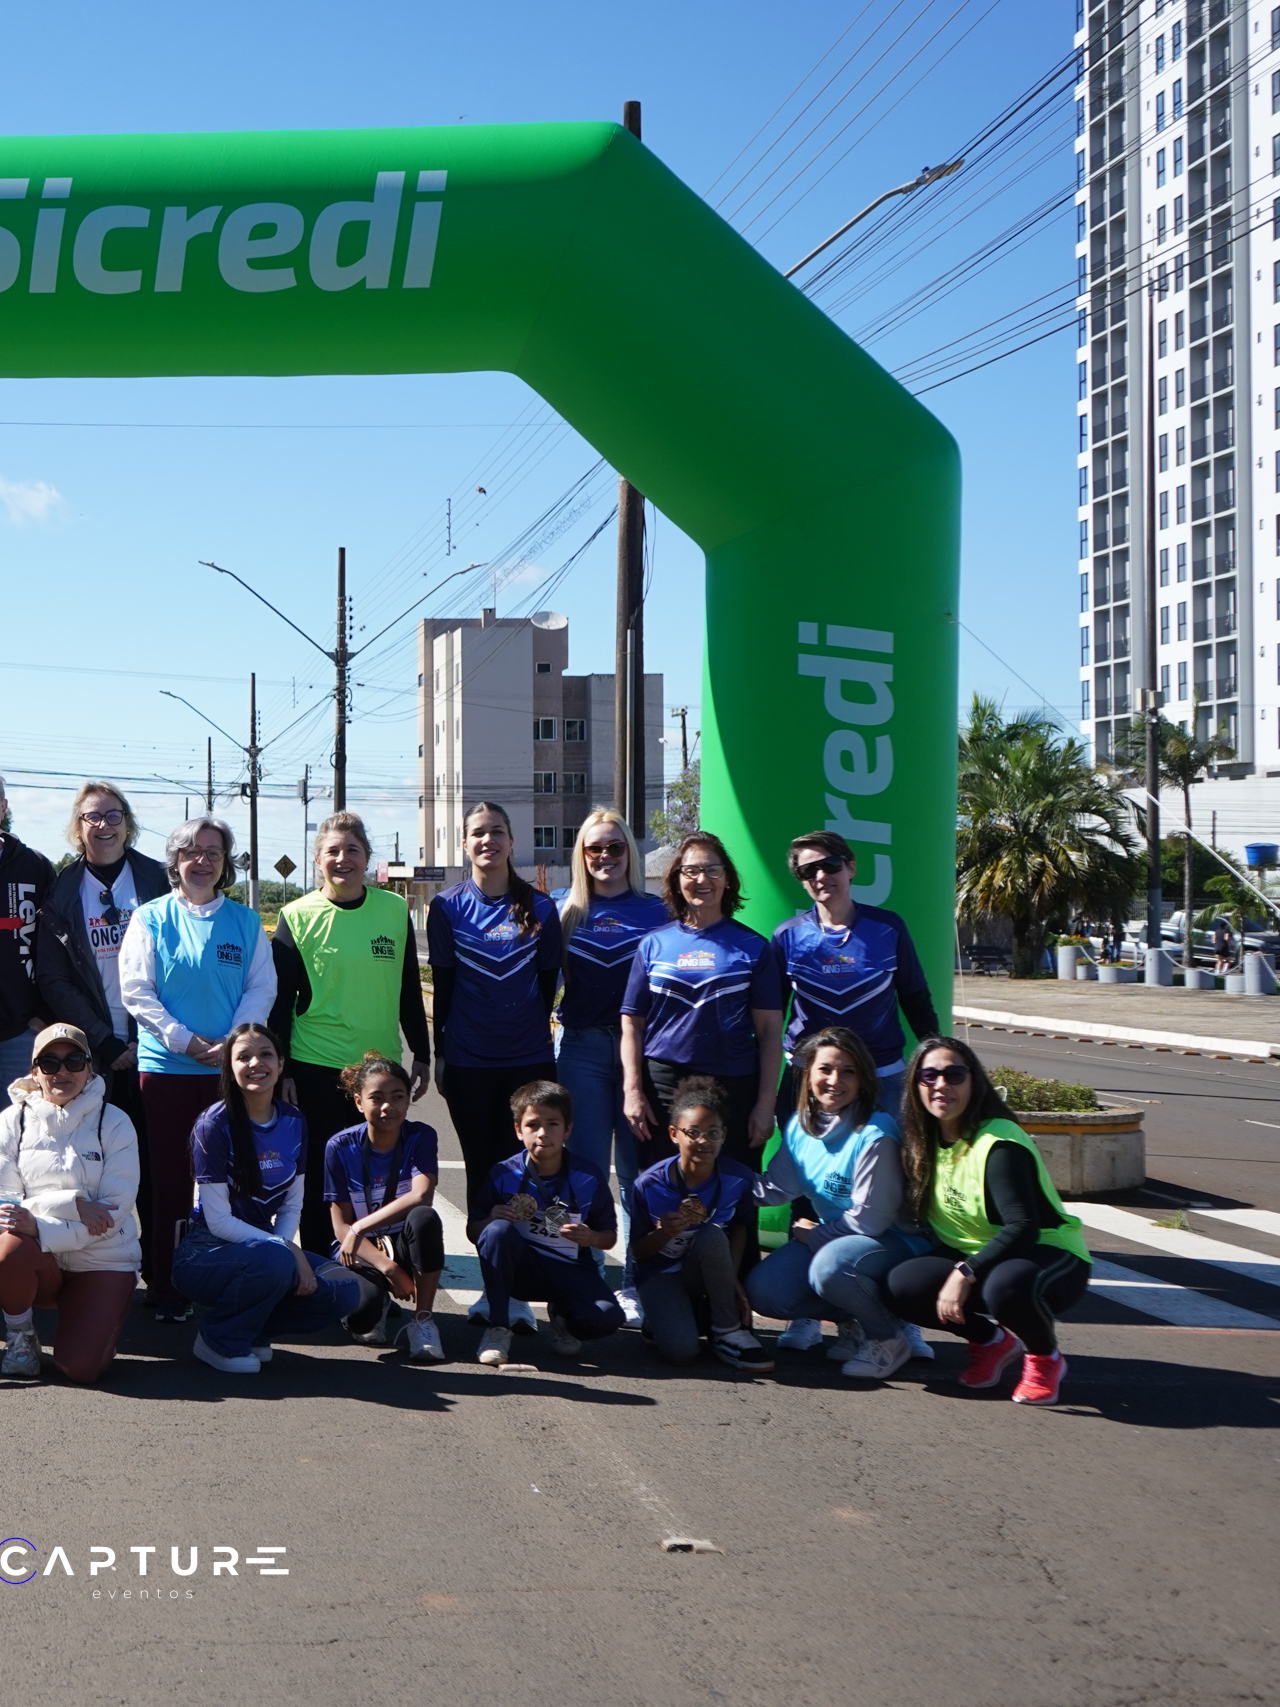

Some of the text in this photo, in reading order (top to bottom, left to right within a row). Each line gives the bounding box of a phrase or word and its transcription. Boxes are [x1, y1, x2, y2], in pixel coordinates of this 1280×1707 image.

[91, 926, 119, 948] ONG
[483, 932, 501, 941] ONG
[371, 945, 386, 955] ONG
[216, 950, 233, 961] ONG
[677, 958, 699, 967] ONG
[822, 964, 840, 974] ONG
[259, 1159, 273, 1170] ONG
